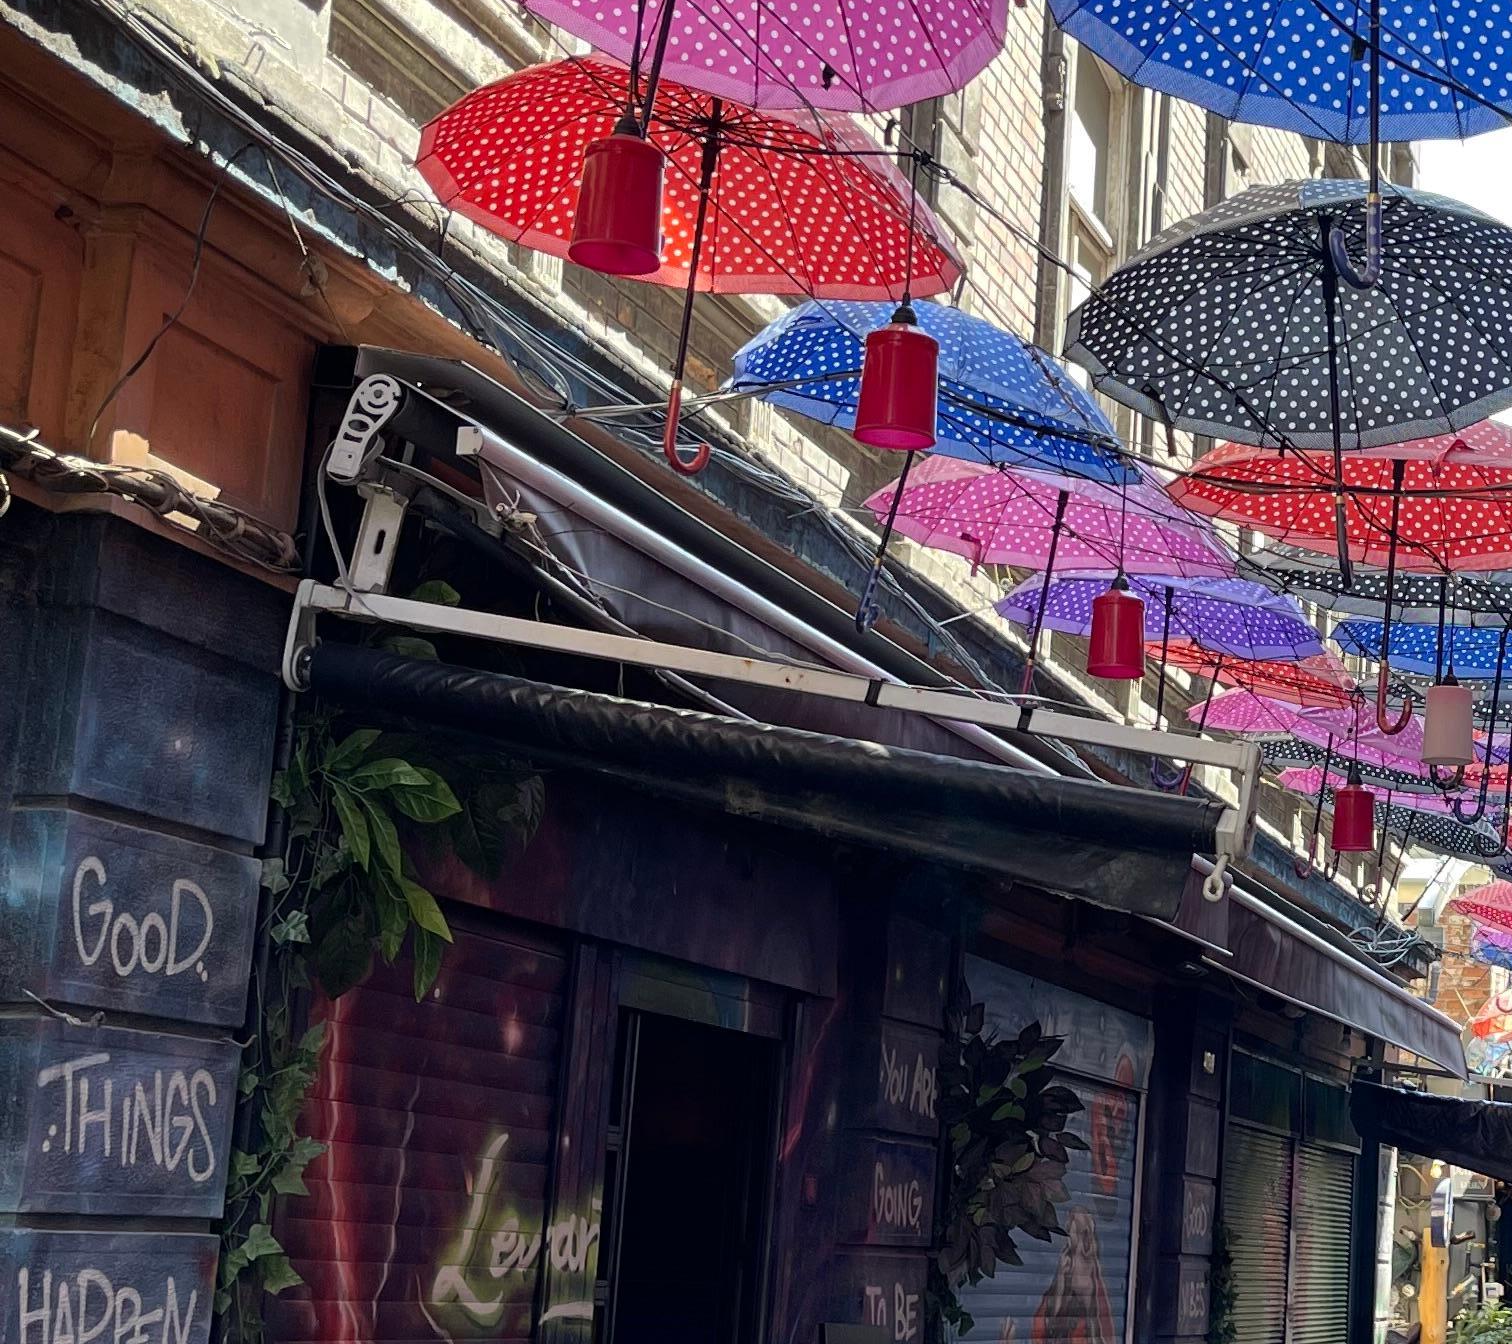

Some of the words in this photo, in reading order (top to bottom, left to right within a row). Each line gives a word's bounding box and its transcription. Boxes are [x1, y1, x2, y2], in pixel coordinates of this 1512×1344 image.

[882, 1044, 909, 1105] YOU
[40, 1053, 216, 1183] THINGS
[875, 1161, 923, 1227] GOING
[894, 1282, 920, 1342] BE
